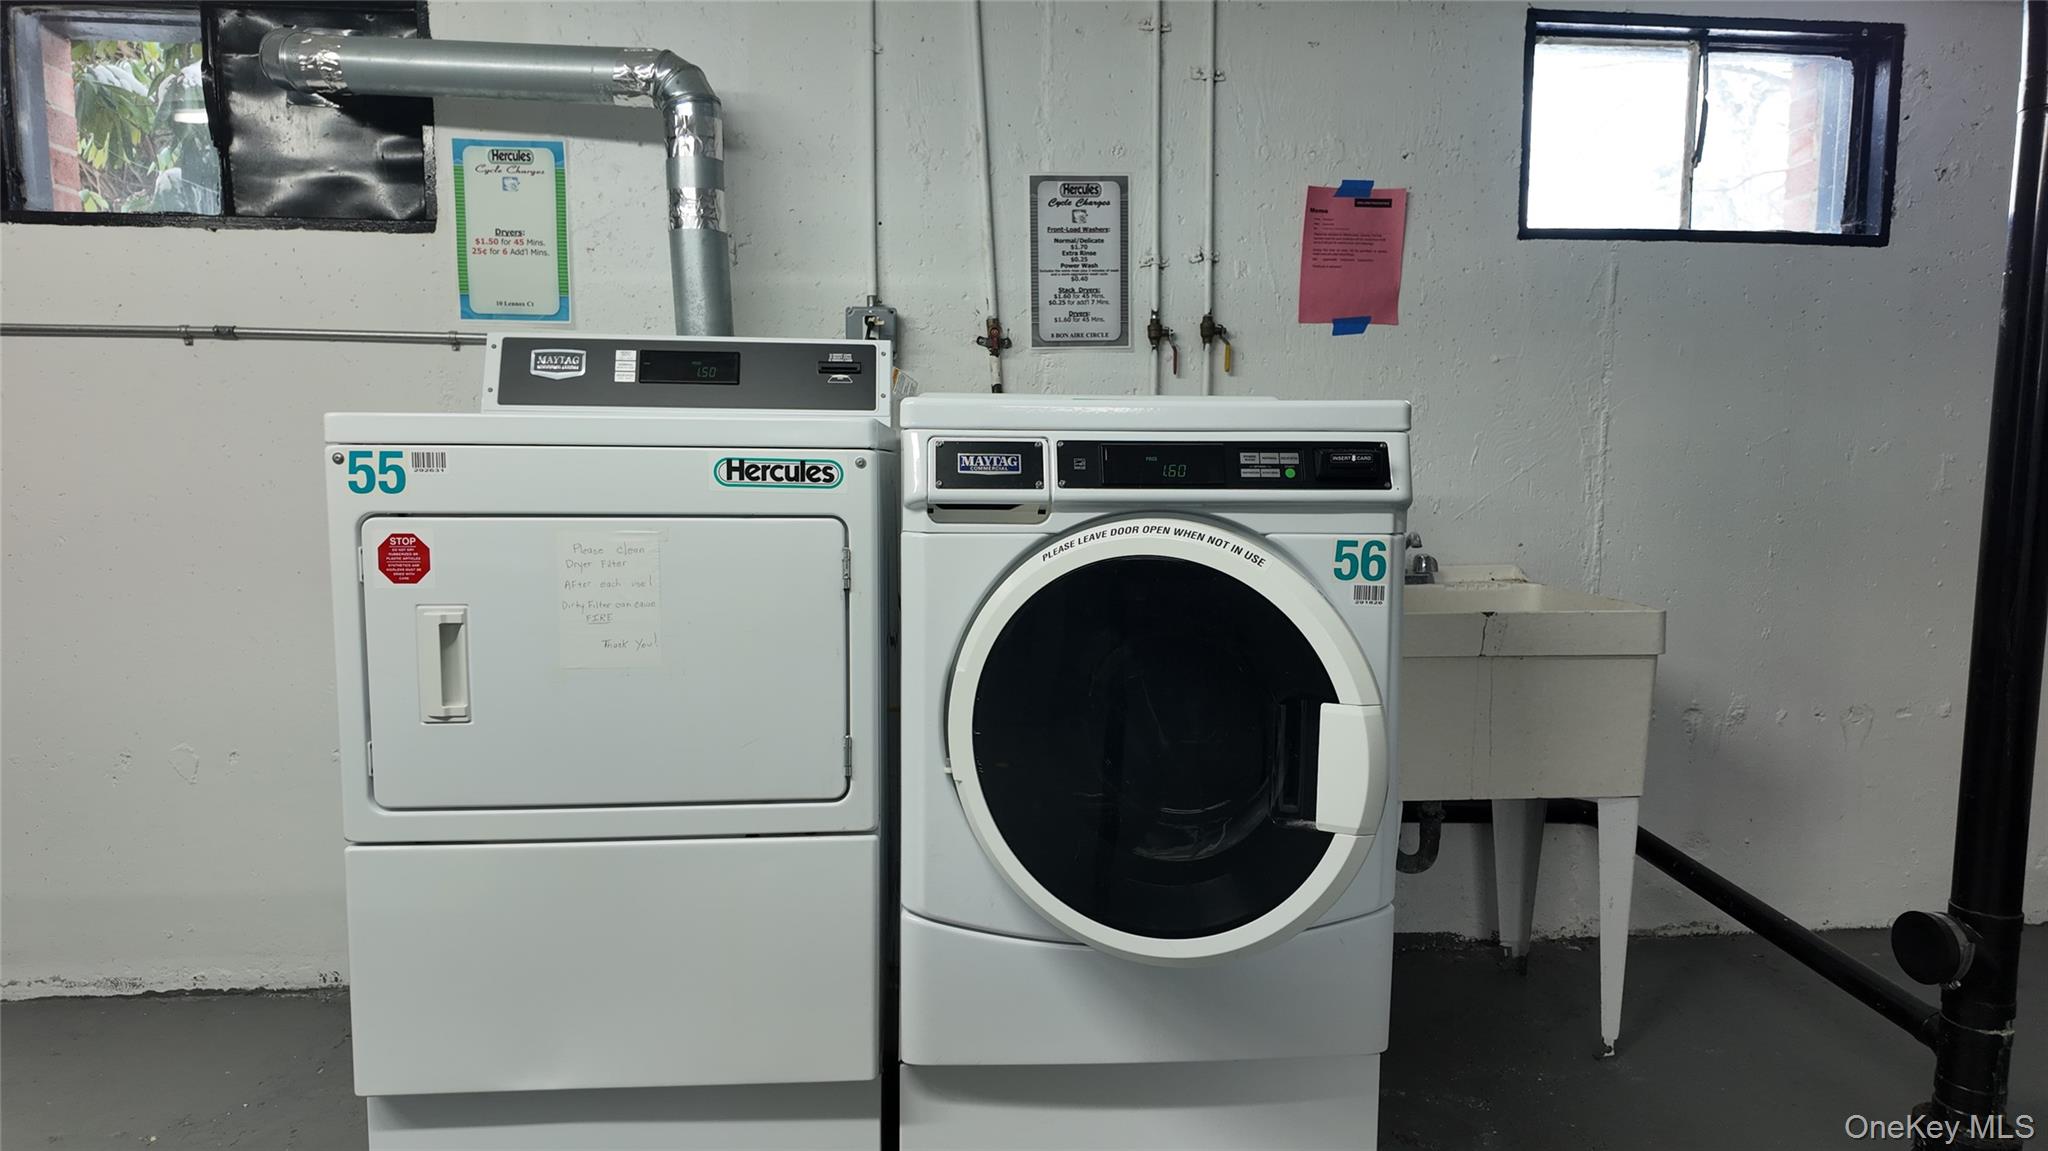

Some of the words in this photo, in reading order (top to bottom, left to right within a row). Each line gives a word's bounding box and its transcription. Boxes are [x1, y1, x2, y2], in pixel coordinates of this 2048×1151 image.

[491, 149, 531, 162] Hercules
[475, 164, 502, 175] Cycle
[506, 165, 545, 176] Charges
[1063, 183, 1099, 195] Hercules
[1048, 198, 1072, 208] Cycle
[1075, 198, 1111, 208] Charges
[495, 228, 526, 238] Dryers:
[1047, 226, 1081, 234] Front-Load
[475, 238, 499, 246] $1.50
[501, 238, 511, 246] for
[527, 239, 545, 247] Mins.
[531, 249, 550, 257] Mins.
[1068, 310, 1090, 318] Dryers:
[536, 355, 580, 365] MAYTAG
[961, 456, 1018, 467] MAYTAG
[1332, 454, 1351, 462] INSERT
[348, 450, 407, 495] 55
[726, 459, 835, 483] Hercules
[1162, 464, 1188, 478] 1.60
[389, 537, 416, 545] STOP
[1042, 539, 1075, 562] PLEASE
[1077, 529, 1108, 546] LEAVE
[1110, 525, 1140, 537] DOOR
[1142, 525, 1171, 535] OPEN
[1173, 527, 1206, 542] WHEN
[1206, 535, 1230, 549] NOT
[1230, 544, 1243, 556] IN
[1244, 550, 1267, 568] USE
[572, 542, 605, 556] Please
[565, 559, 593, 575] Dryer
[1334, 540, 1387, 582] 56
[599, 577, 622, 589] each
[561, 600, 586, 615] Dirty
[587, 600, 612, 609] Filter
[585, 612, 614, 625] FIRE
